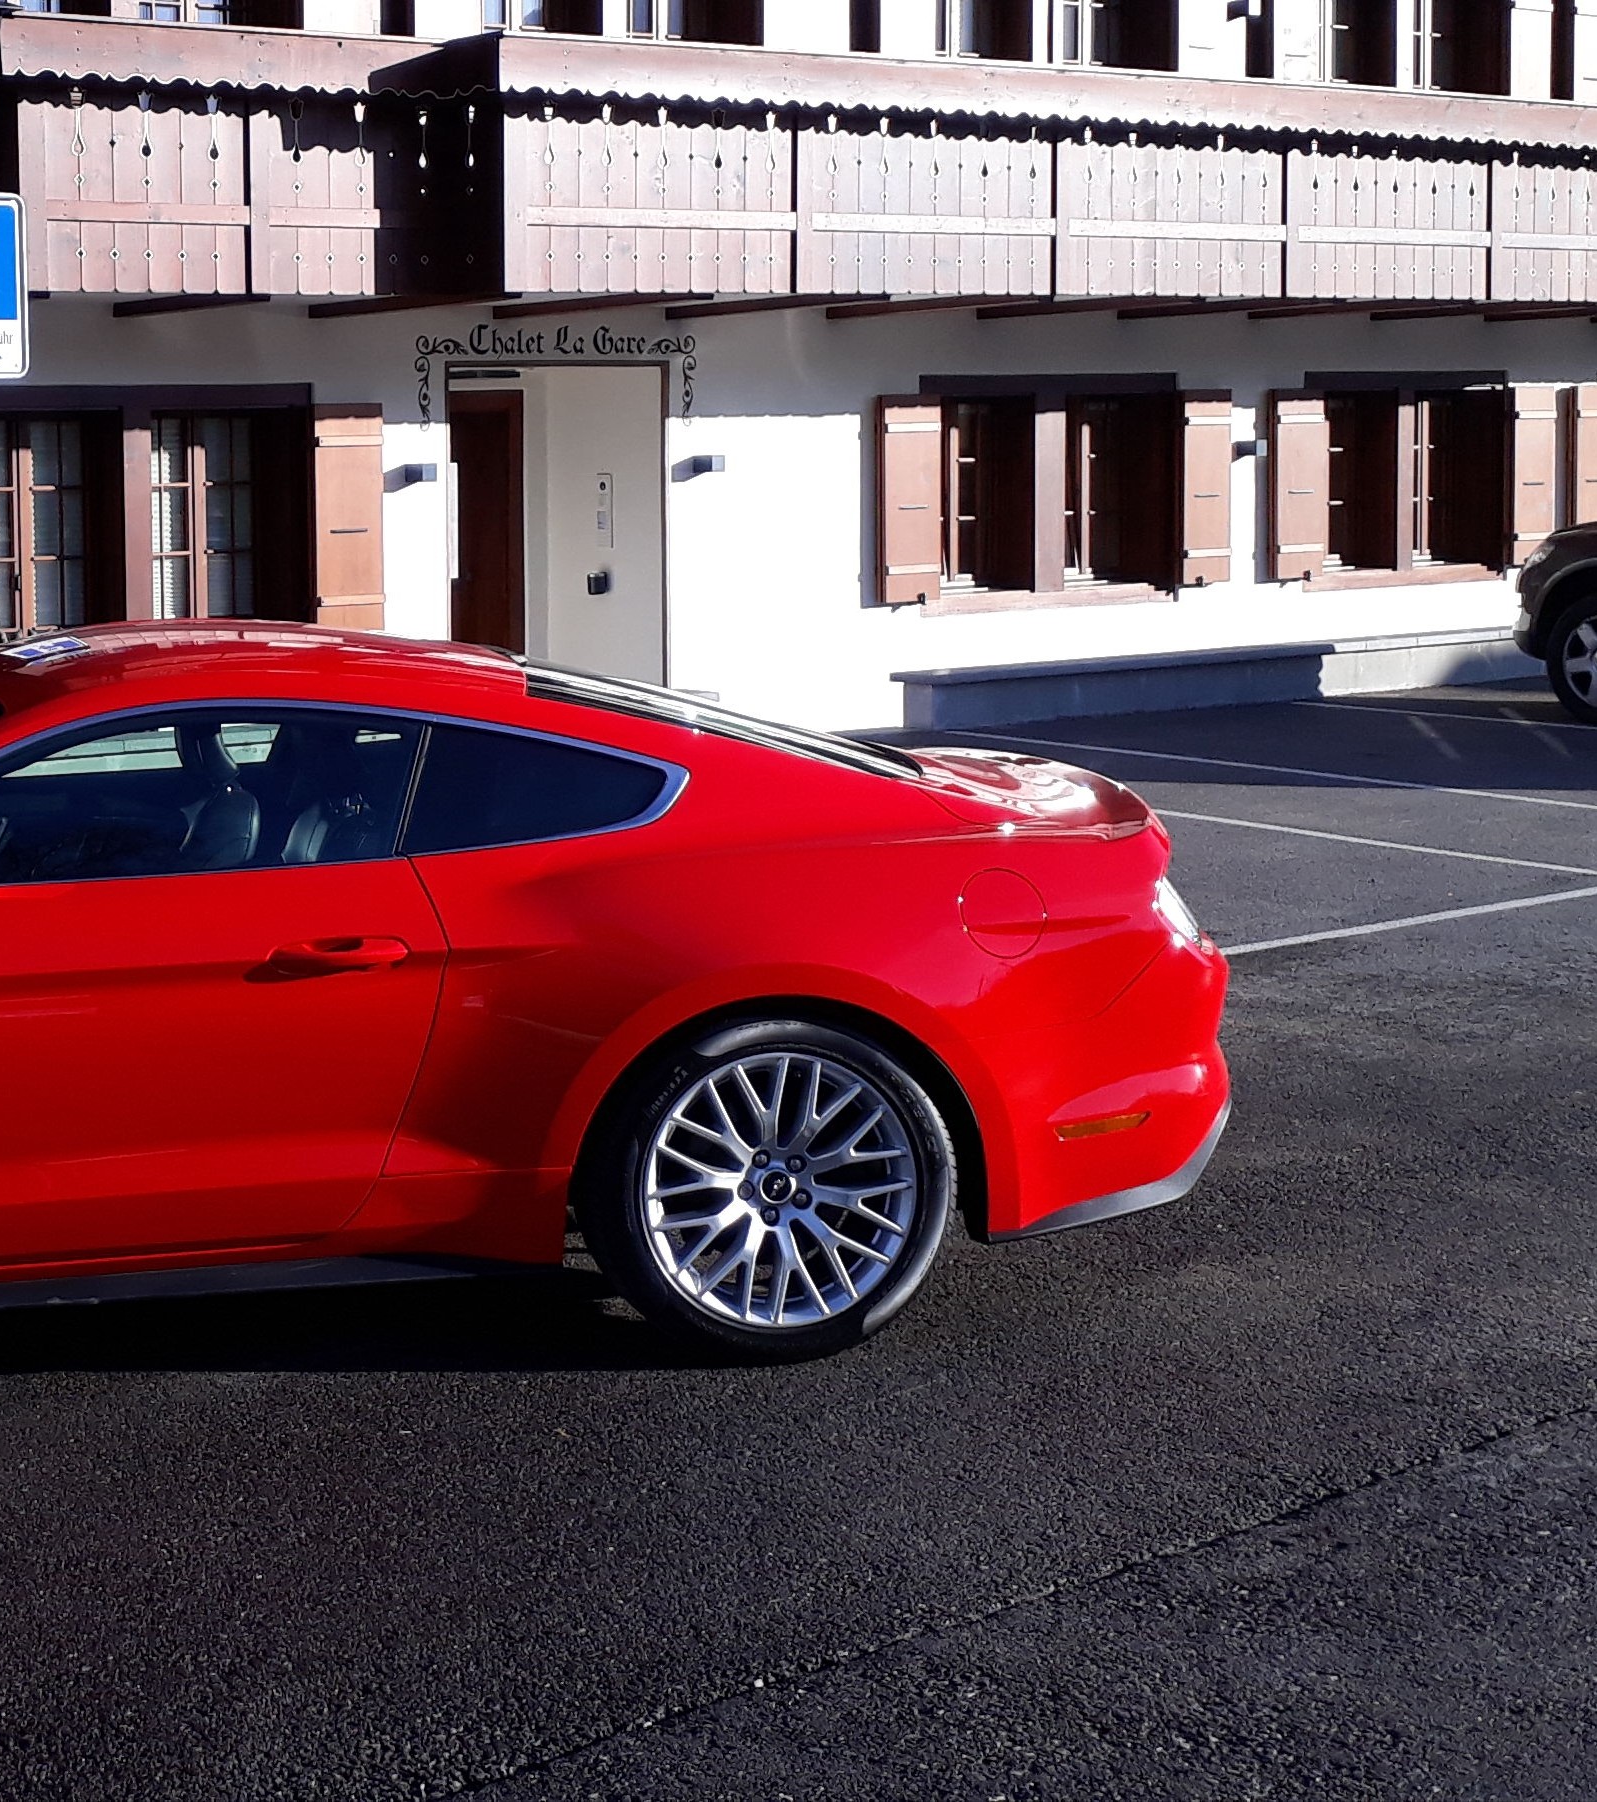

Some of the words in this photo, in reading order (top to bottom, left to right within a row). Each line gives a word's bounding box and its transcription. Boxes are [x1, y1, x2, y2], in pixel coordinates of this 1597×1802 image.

[469, 324, 545, 360] Chalet
[554, 325, 585, 355] La
[593, 325, 646, 355] Gare
